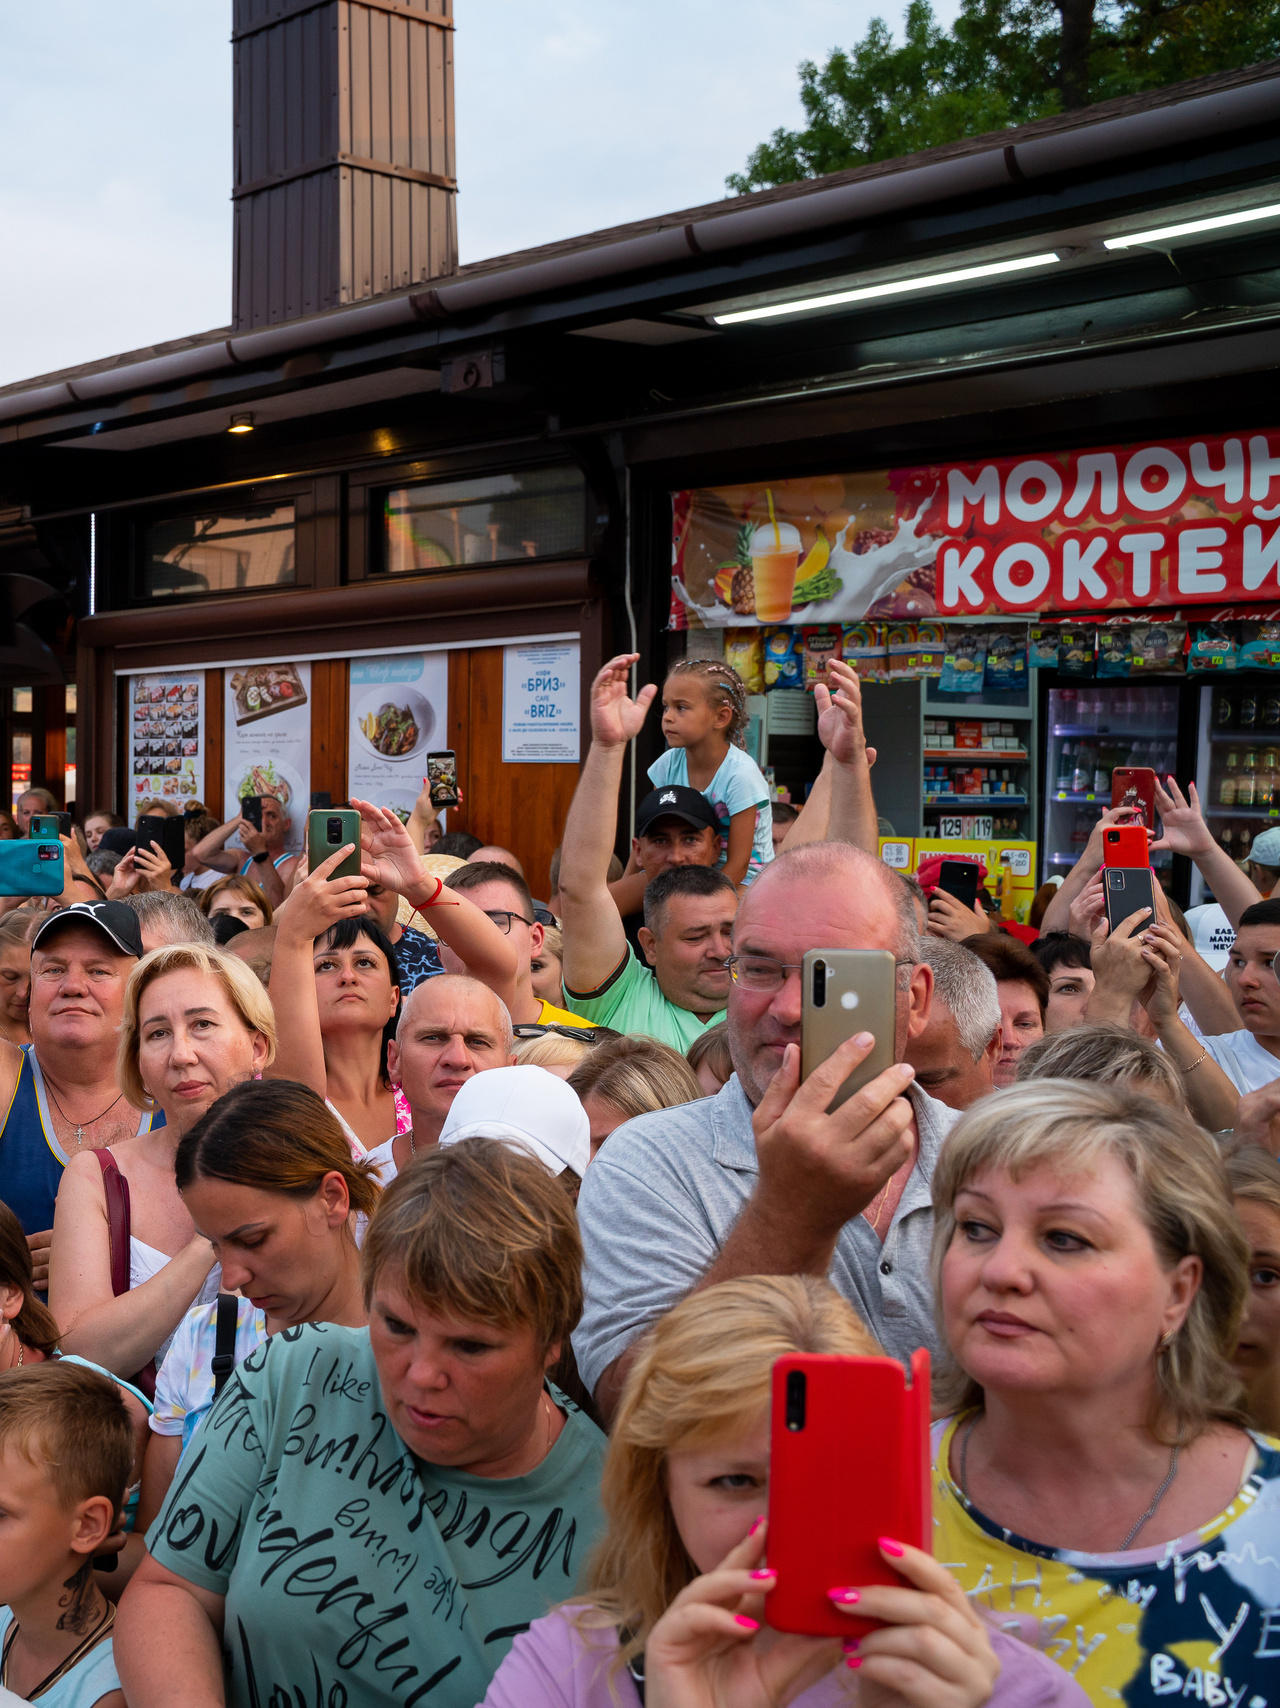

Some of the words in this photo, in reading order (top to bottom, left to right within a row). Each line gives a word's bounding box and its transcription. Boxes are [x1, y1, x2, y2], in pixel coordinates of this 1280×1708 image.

[521, 677, 566, 692] «БРИЗ»
[524, 704, 562, 718] «BRIZ»
[941, 818, 962, 837] 129
[975, 817, 992, 837] 119
[302, 1346, 323, 1387] I
[322, 1356, 371, 1403] like
